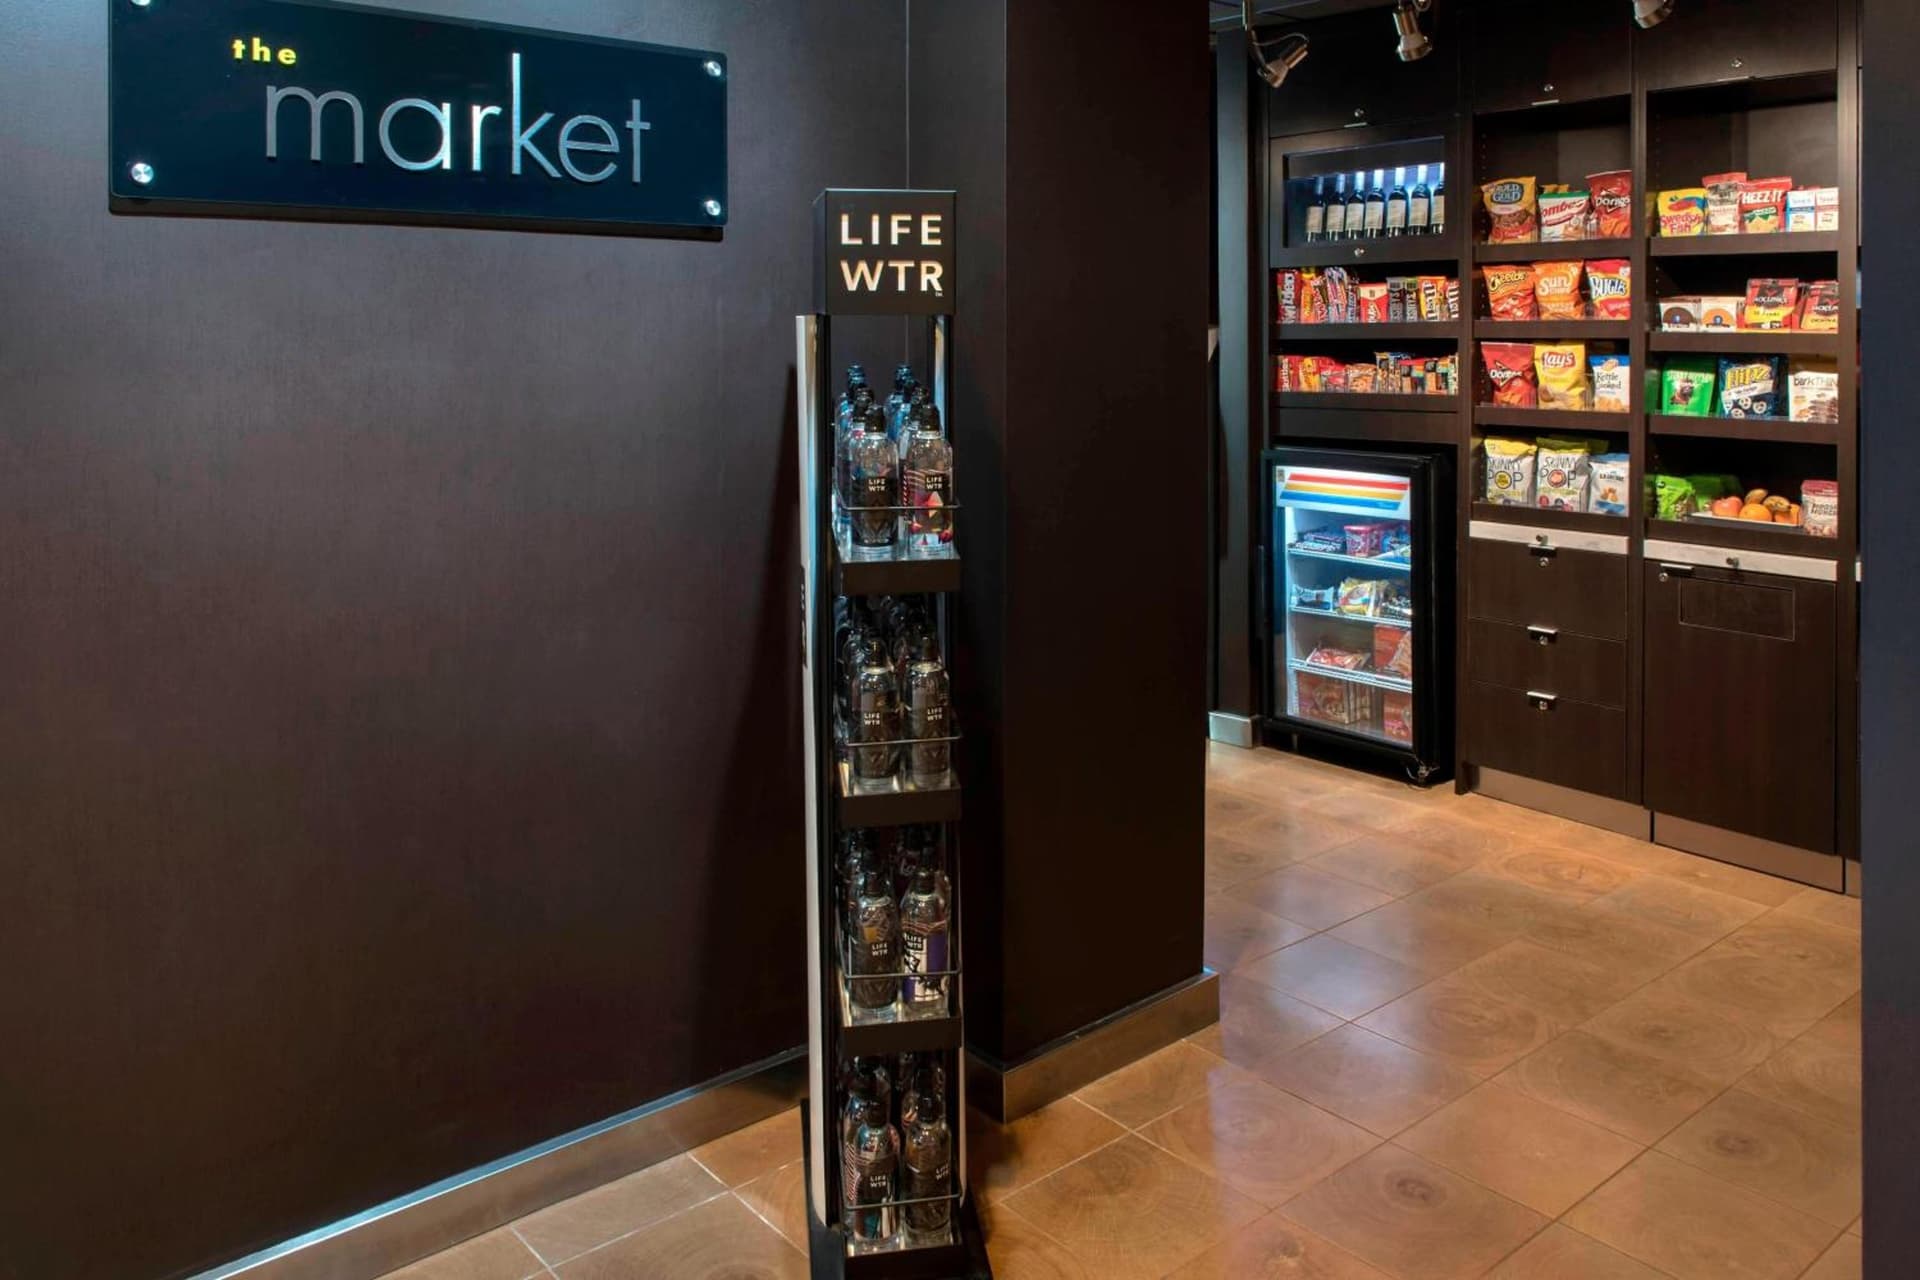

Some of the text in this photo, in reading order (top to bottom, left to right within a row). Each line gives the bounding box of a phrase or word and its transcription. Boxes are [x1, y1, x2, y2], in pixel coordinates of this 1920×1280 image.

[232, 37, 297, 65] the
[264, 52, 651, 183] market
[840, 213, 943, 246] LIFE
[840, 260, 944, 292] WTR
[1538, 276, 1569, 296] Sun
